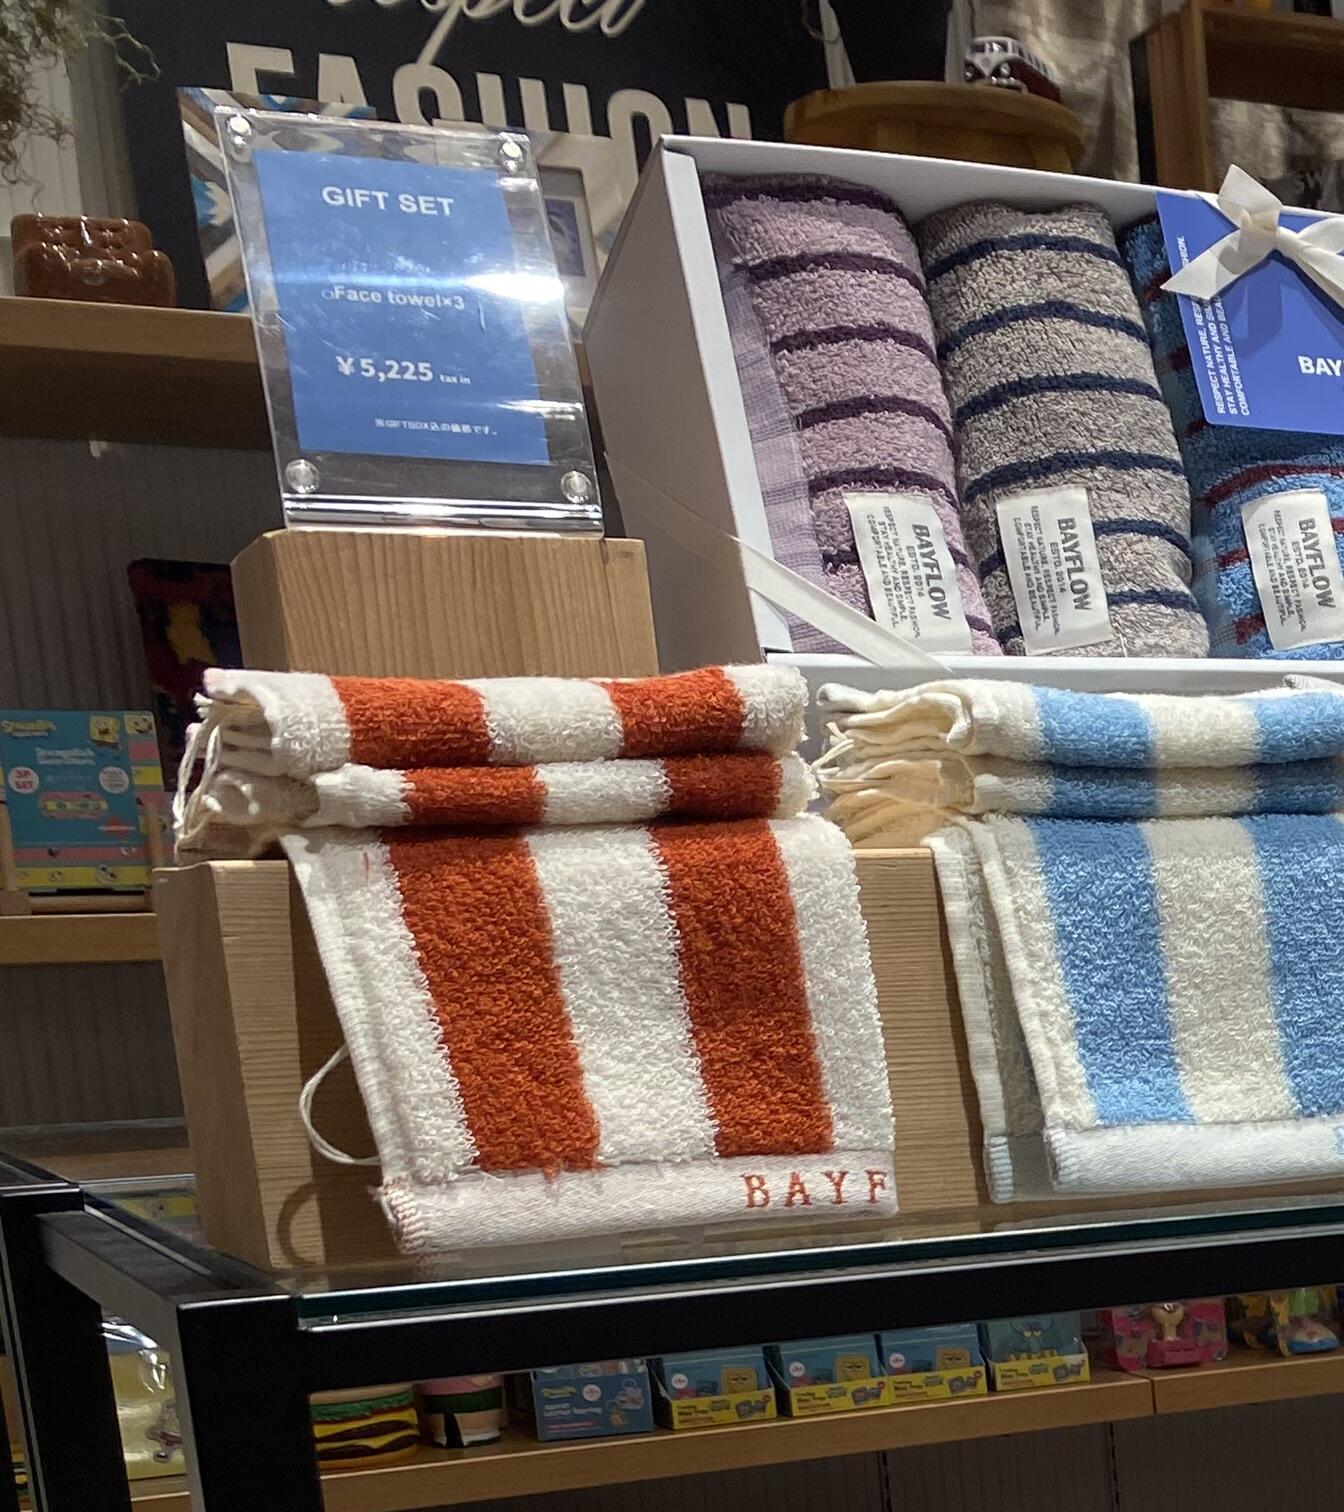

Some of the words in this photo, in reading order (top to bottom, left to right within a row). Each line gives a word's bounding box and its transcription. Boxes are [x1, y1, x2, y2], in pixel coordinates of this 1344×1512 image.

[322, 186, 388, 210] GIFT
[398, 194, 454, 216] SET
[1206, 322, 1220, 342] AND
[1218, 323, 1231, 343] AND
[336, 355, 434, 382] ¥5,225
[439, 373, 458, 384] tax
[459, 375, 472, 385] in
[1212, 344, 1232, 388] HEALTHY
[1224, 345, 1250, 416] COMFORTABLE
[1206, 368, 1227, 414] RESPECT
[1224, 390, 1238, 415] STAY
[911, 523, 952, 619] BAYFLOW
[1056, 516, 1092, 610] BAYFLOW
[1296, 517, 1336, 609] BAYFLOW
[740, 1169, 887, 1208] BAYF
